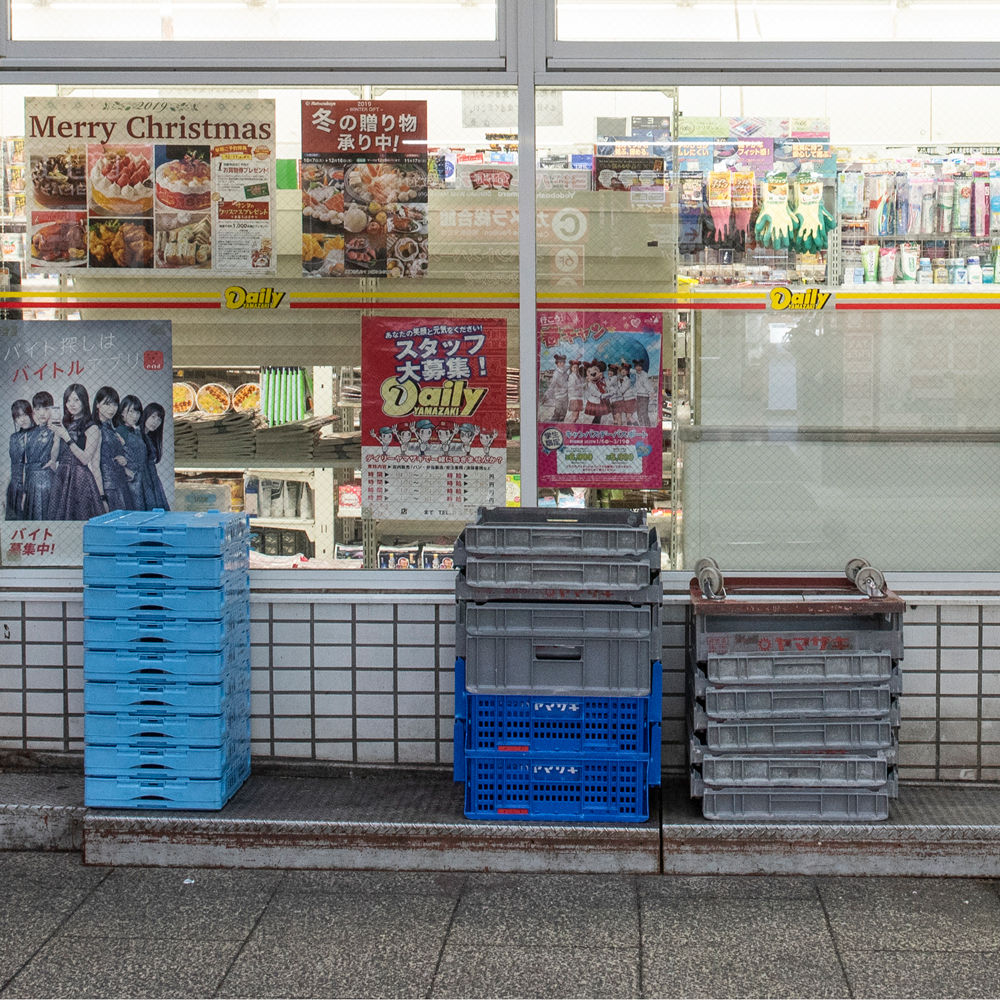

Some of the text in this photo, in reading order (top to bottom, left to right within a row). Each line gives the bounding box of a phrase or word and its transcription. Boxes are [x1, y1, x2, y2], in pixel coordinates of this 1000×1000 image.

[135, 101, 167, 112] 2019
[28, 114, 272, 145] Merry Christmas
[312, 107, 417, 133] 冬の贈り物
[337, 133, 400, 153] 承り中!
[224, 286, 286, 309] Daily
[769, 287, 832, 310] Daily
[4, 332, 116, 361] バイト探しは
[395, 334, 486, 360] スタッフ
[12, 360, 85, 382] バイトル
[395, 356, 488, 384] 大募集!
[380, 376, 489, 417] Daily
[413, 406, 461, 416] YAMAZAKI
[11, 527, 53, 541] バイト
[9, 542, 56, 556] 募集中!
[775, 636, 849, 652] ヤマザキ
